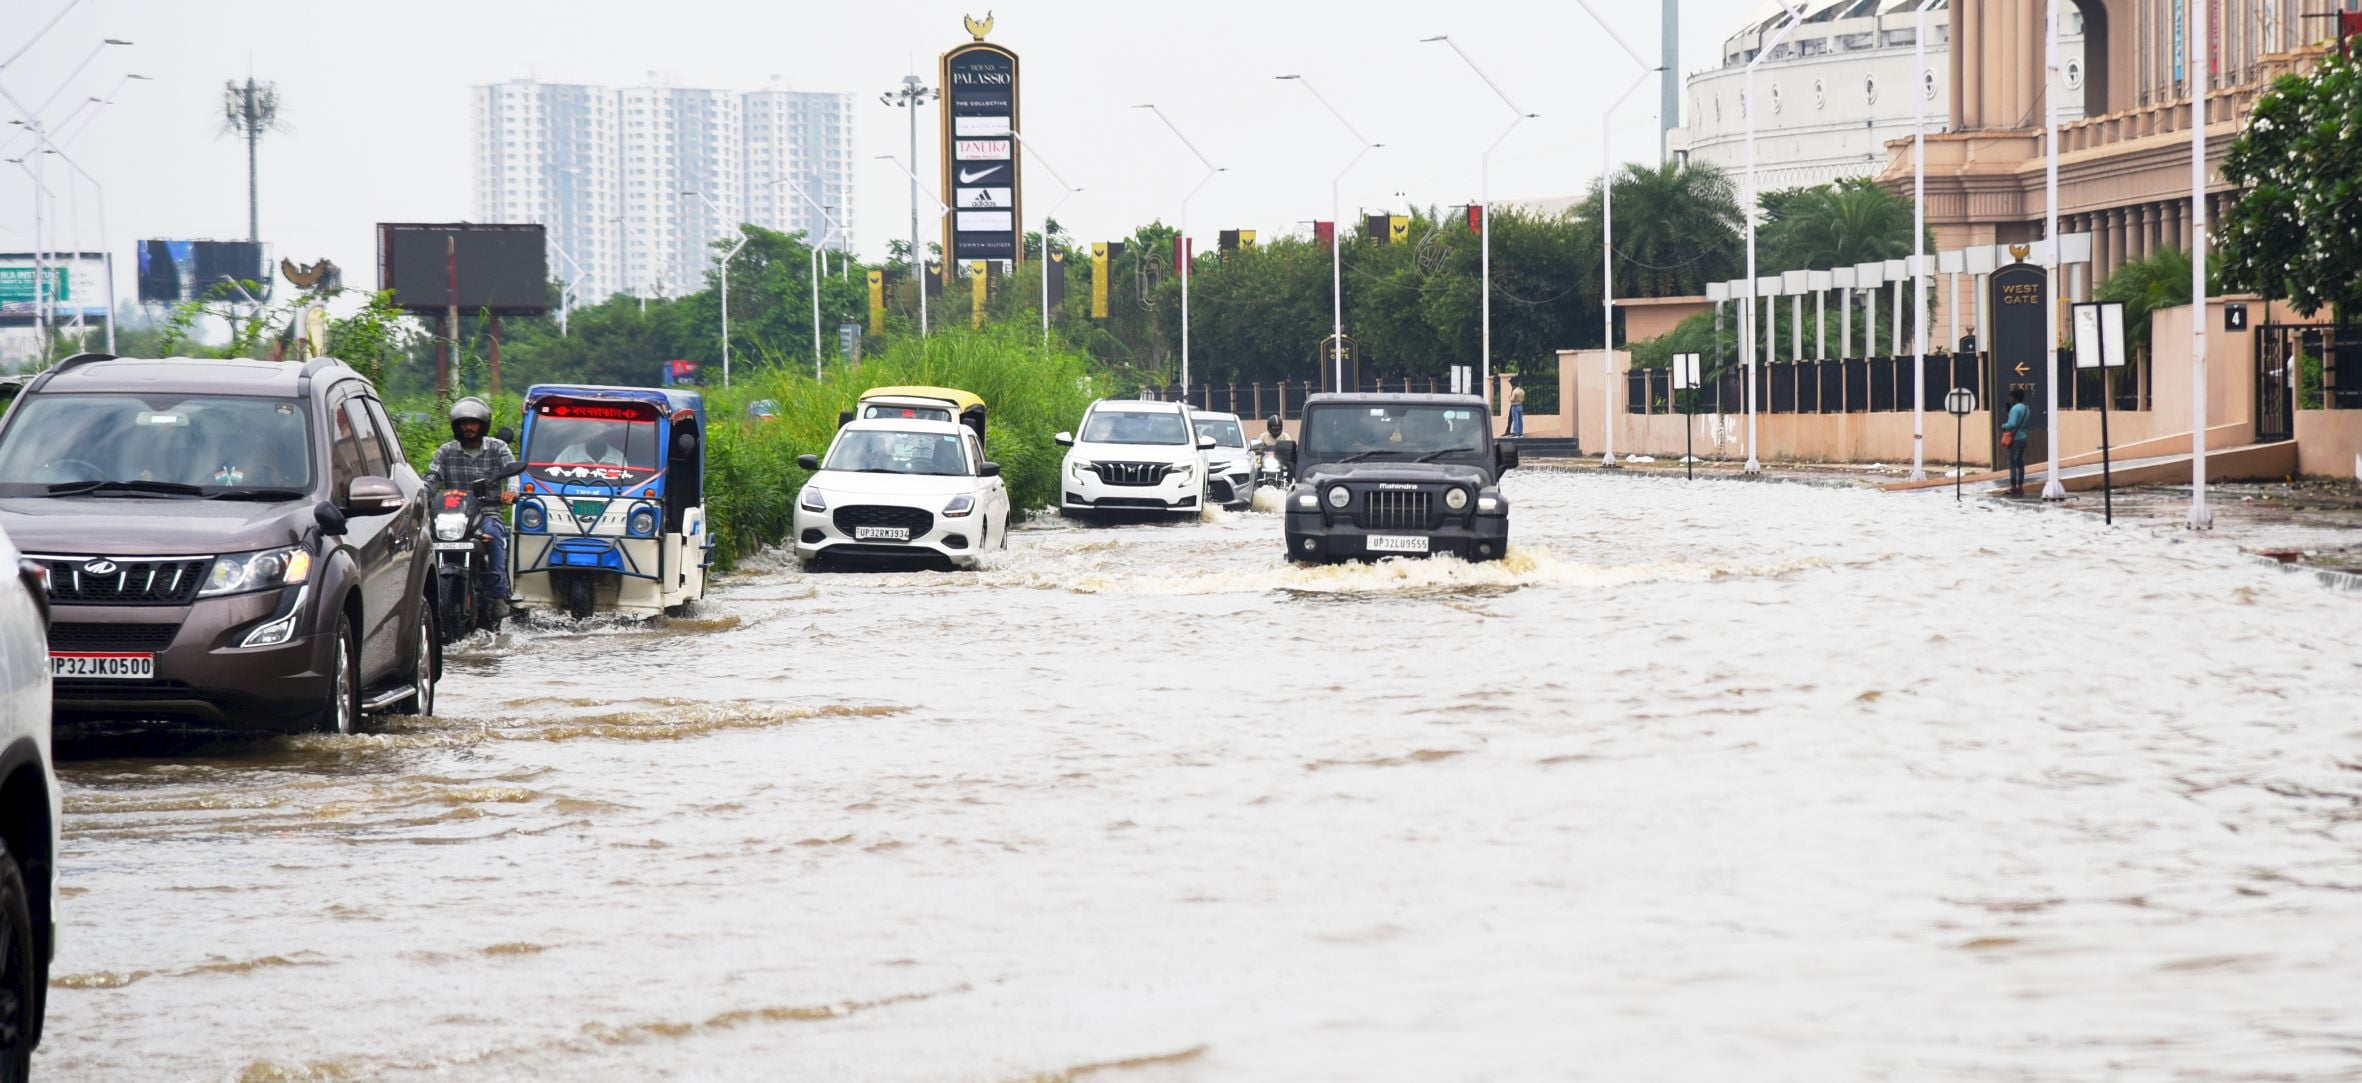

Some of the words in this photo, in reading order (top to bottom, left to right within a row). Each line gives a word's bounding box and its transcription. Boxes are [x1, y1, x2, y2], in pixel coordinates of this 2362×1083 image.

[953, 73, 1011, 84] PALASSIO
[960, 142, 1008, 153] TANEIRA
[971, 200, 997, 208] adidas
[2002, 284, 2039, 294] WEST
[2004, 295, 2039, 304] GATE
[2231, 311, 2240, 325] 4
[2009, 383, 2036, 391] EXIT
[860, 528, 909, 538] UP32RM3934
[1373, 537, 1427, 549] UP32LU9555
